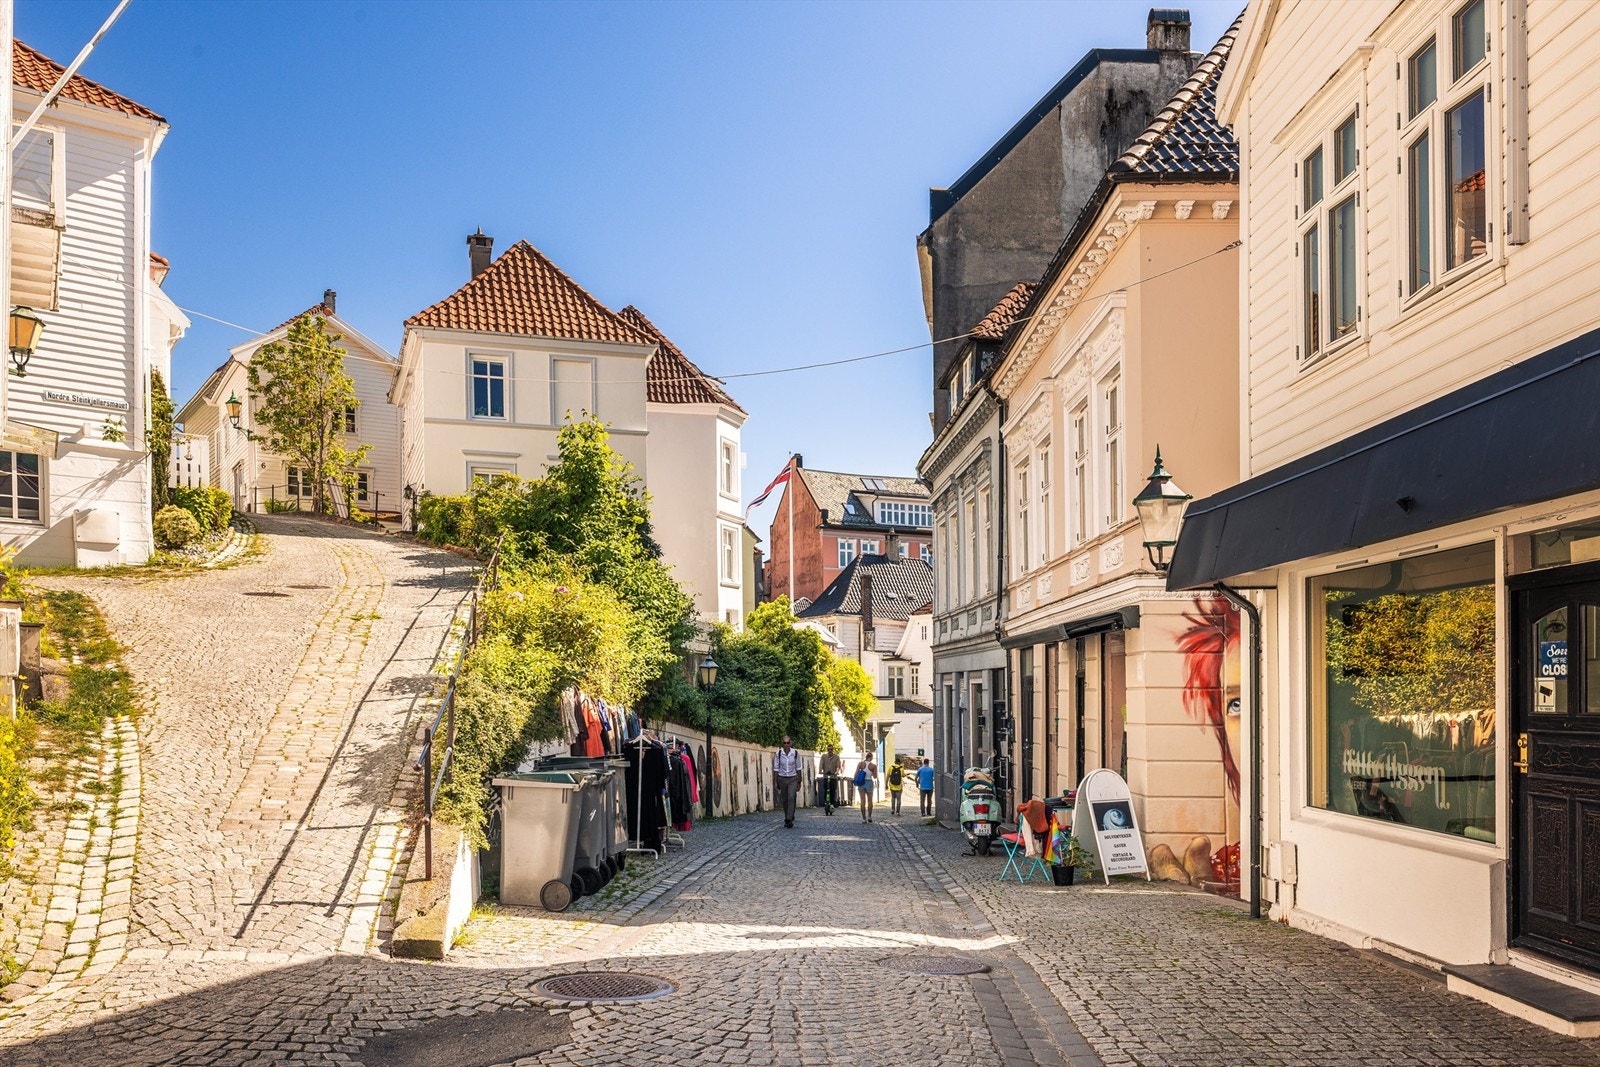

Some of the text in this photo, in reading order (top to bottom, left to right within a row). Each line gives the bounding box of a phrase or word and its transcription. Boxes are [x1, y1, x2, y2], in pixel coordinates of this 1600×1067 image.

[47, 391, 128, 410] Nordre Steinkjellersmauet
[261, 461, 267, 470] 6
[1546, 644, 1568, 657] Sorr
[1542, 664, 1567, 676] CLOS
